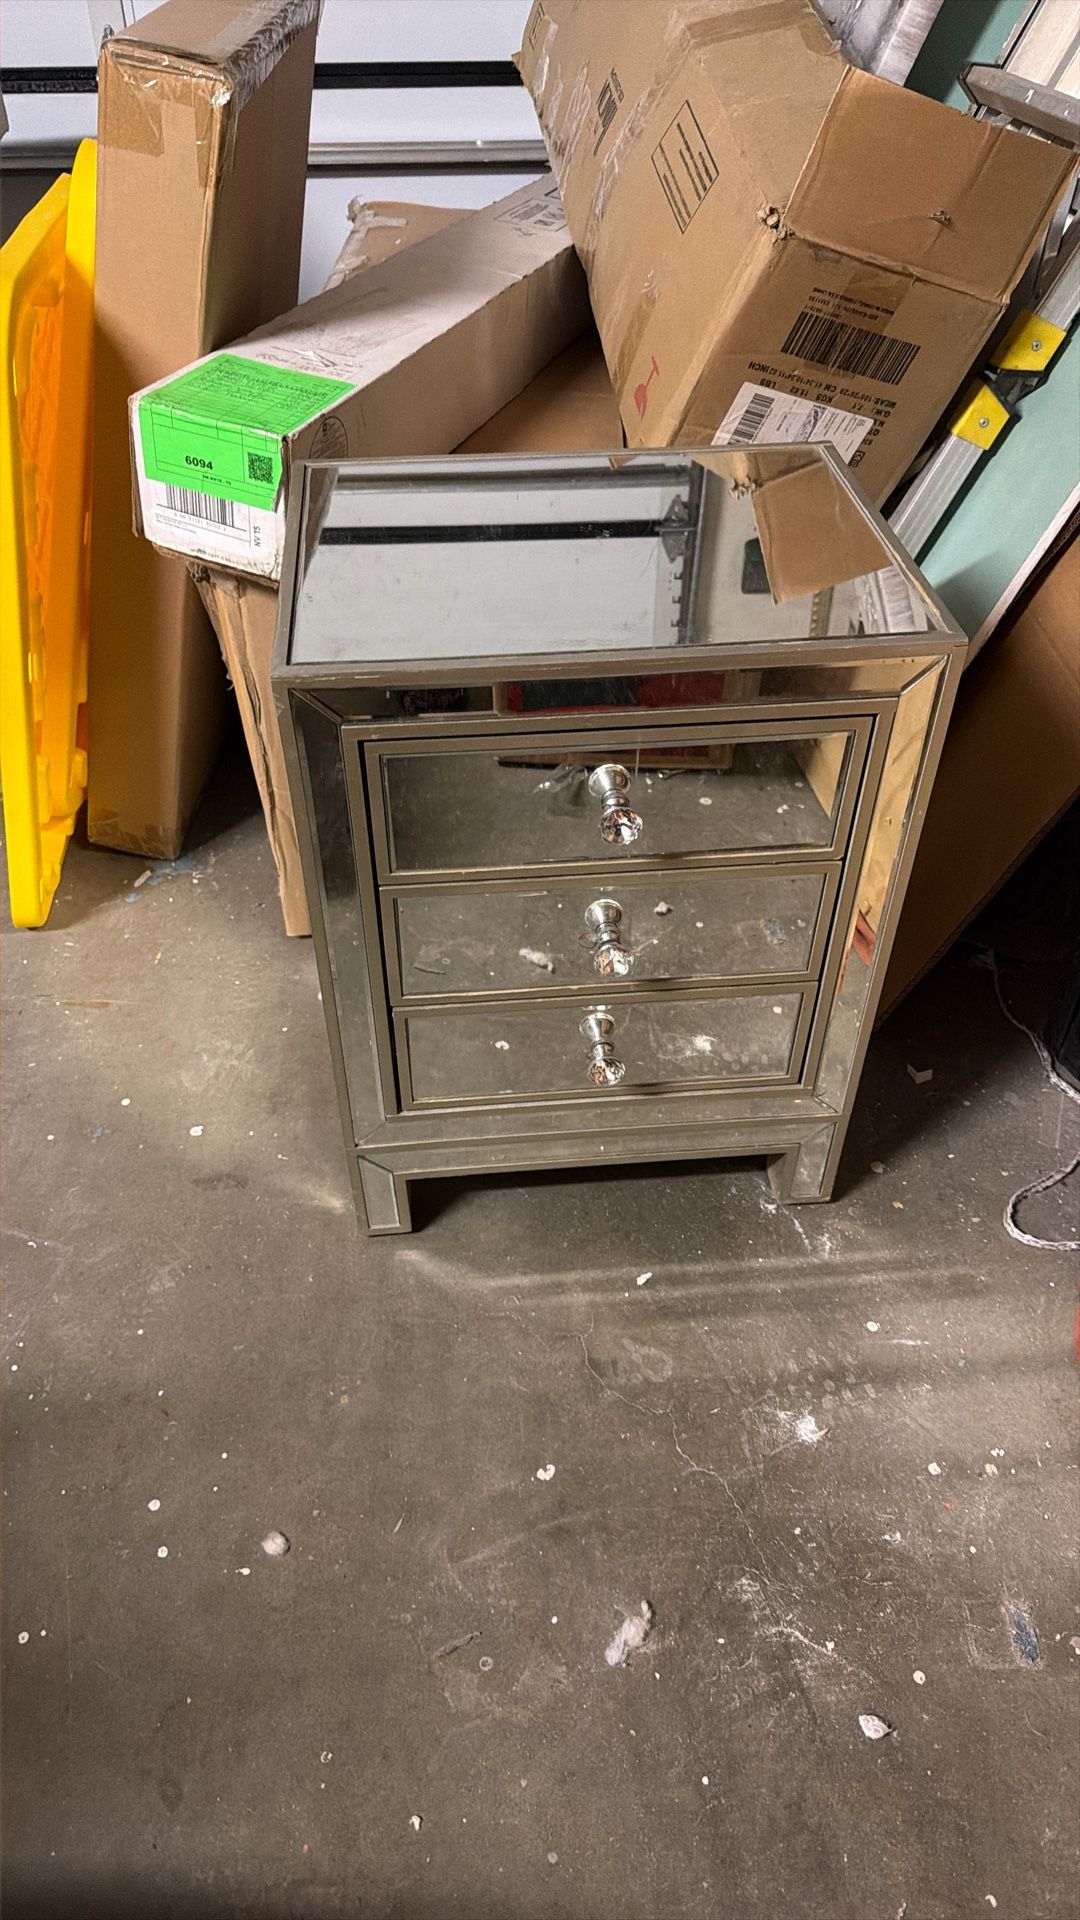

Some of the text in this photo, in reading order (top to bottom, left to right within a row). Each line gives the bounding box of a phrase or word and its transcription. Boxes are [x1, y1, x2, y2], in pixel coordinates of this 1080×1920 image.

[759, 378, 775, 388] LBS
[822, 383, 837, 393] CM
[815, 392, 832, 404] KGS
[185, 455, 213, 470] 6094
